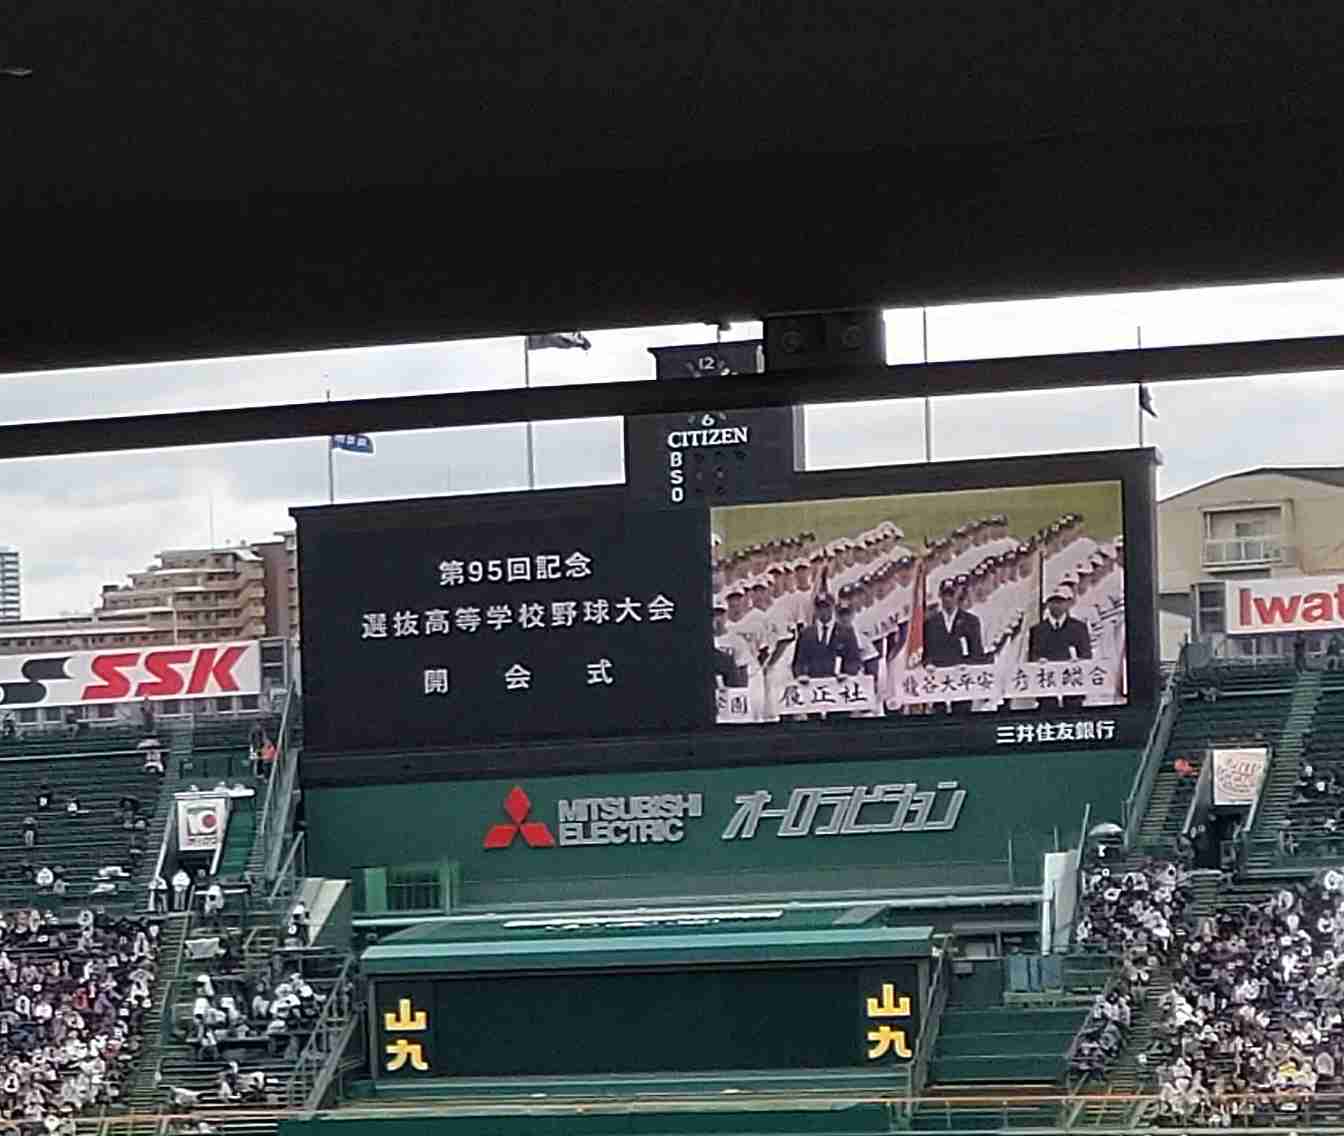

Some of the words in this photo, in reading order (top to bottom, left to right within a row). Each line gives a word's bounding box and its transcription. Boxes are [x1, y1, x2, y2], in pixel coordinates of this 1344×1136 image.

[667, 427, 749, 448] CITIZEN
[669, 451, 683, 467] B
[669, 469, 684, 485] S
[439, 552, 592, 587] 第95回記念
[361, 593, 675, 639] 選抜高等学校野球大会
[81, 646, 250, 701] SSK
[995, 719, 1115, 744] 三井住友銀行
[557, 794, 703, 823] MITSUBISHI
[721, 781, 968, 839] オーロラビジョン
[558, 817, 685, 847] ELECTRIC
[384, 998, 430, 1072] 山九
[867, 983, 913, 1060] 山九
